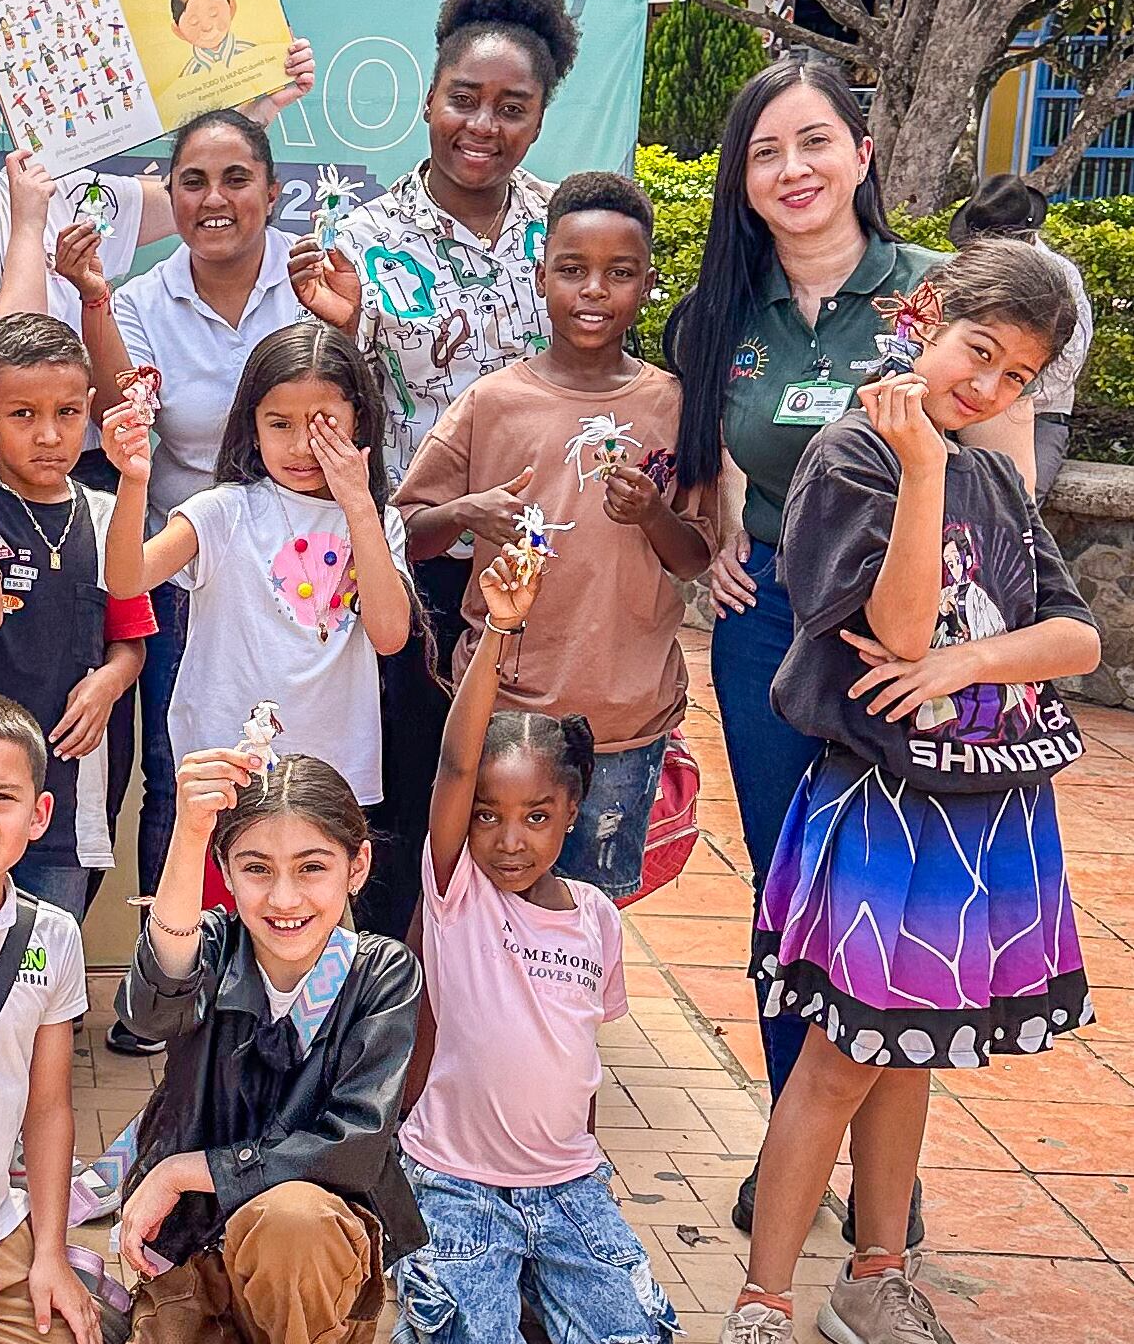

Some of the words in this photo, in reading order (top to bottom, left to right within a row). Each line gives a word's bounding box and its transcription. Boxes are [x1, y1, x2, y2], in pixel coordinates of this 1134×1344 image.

[908, 732, 1084, 774] SHINOBU
[523, 948, 603, 978] MEMORIES
[528, 966, 572, 983] LOVES
